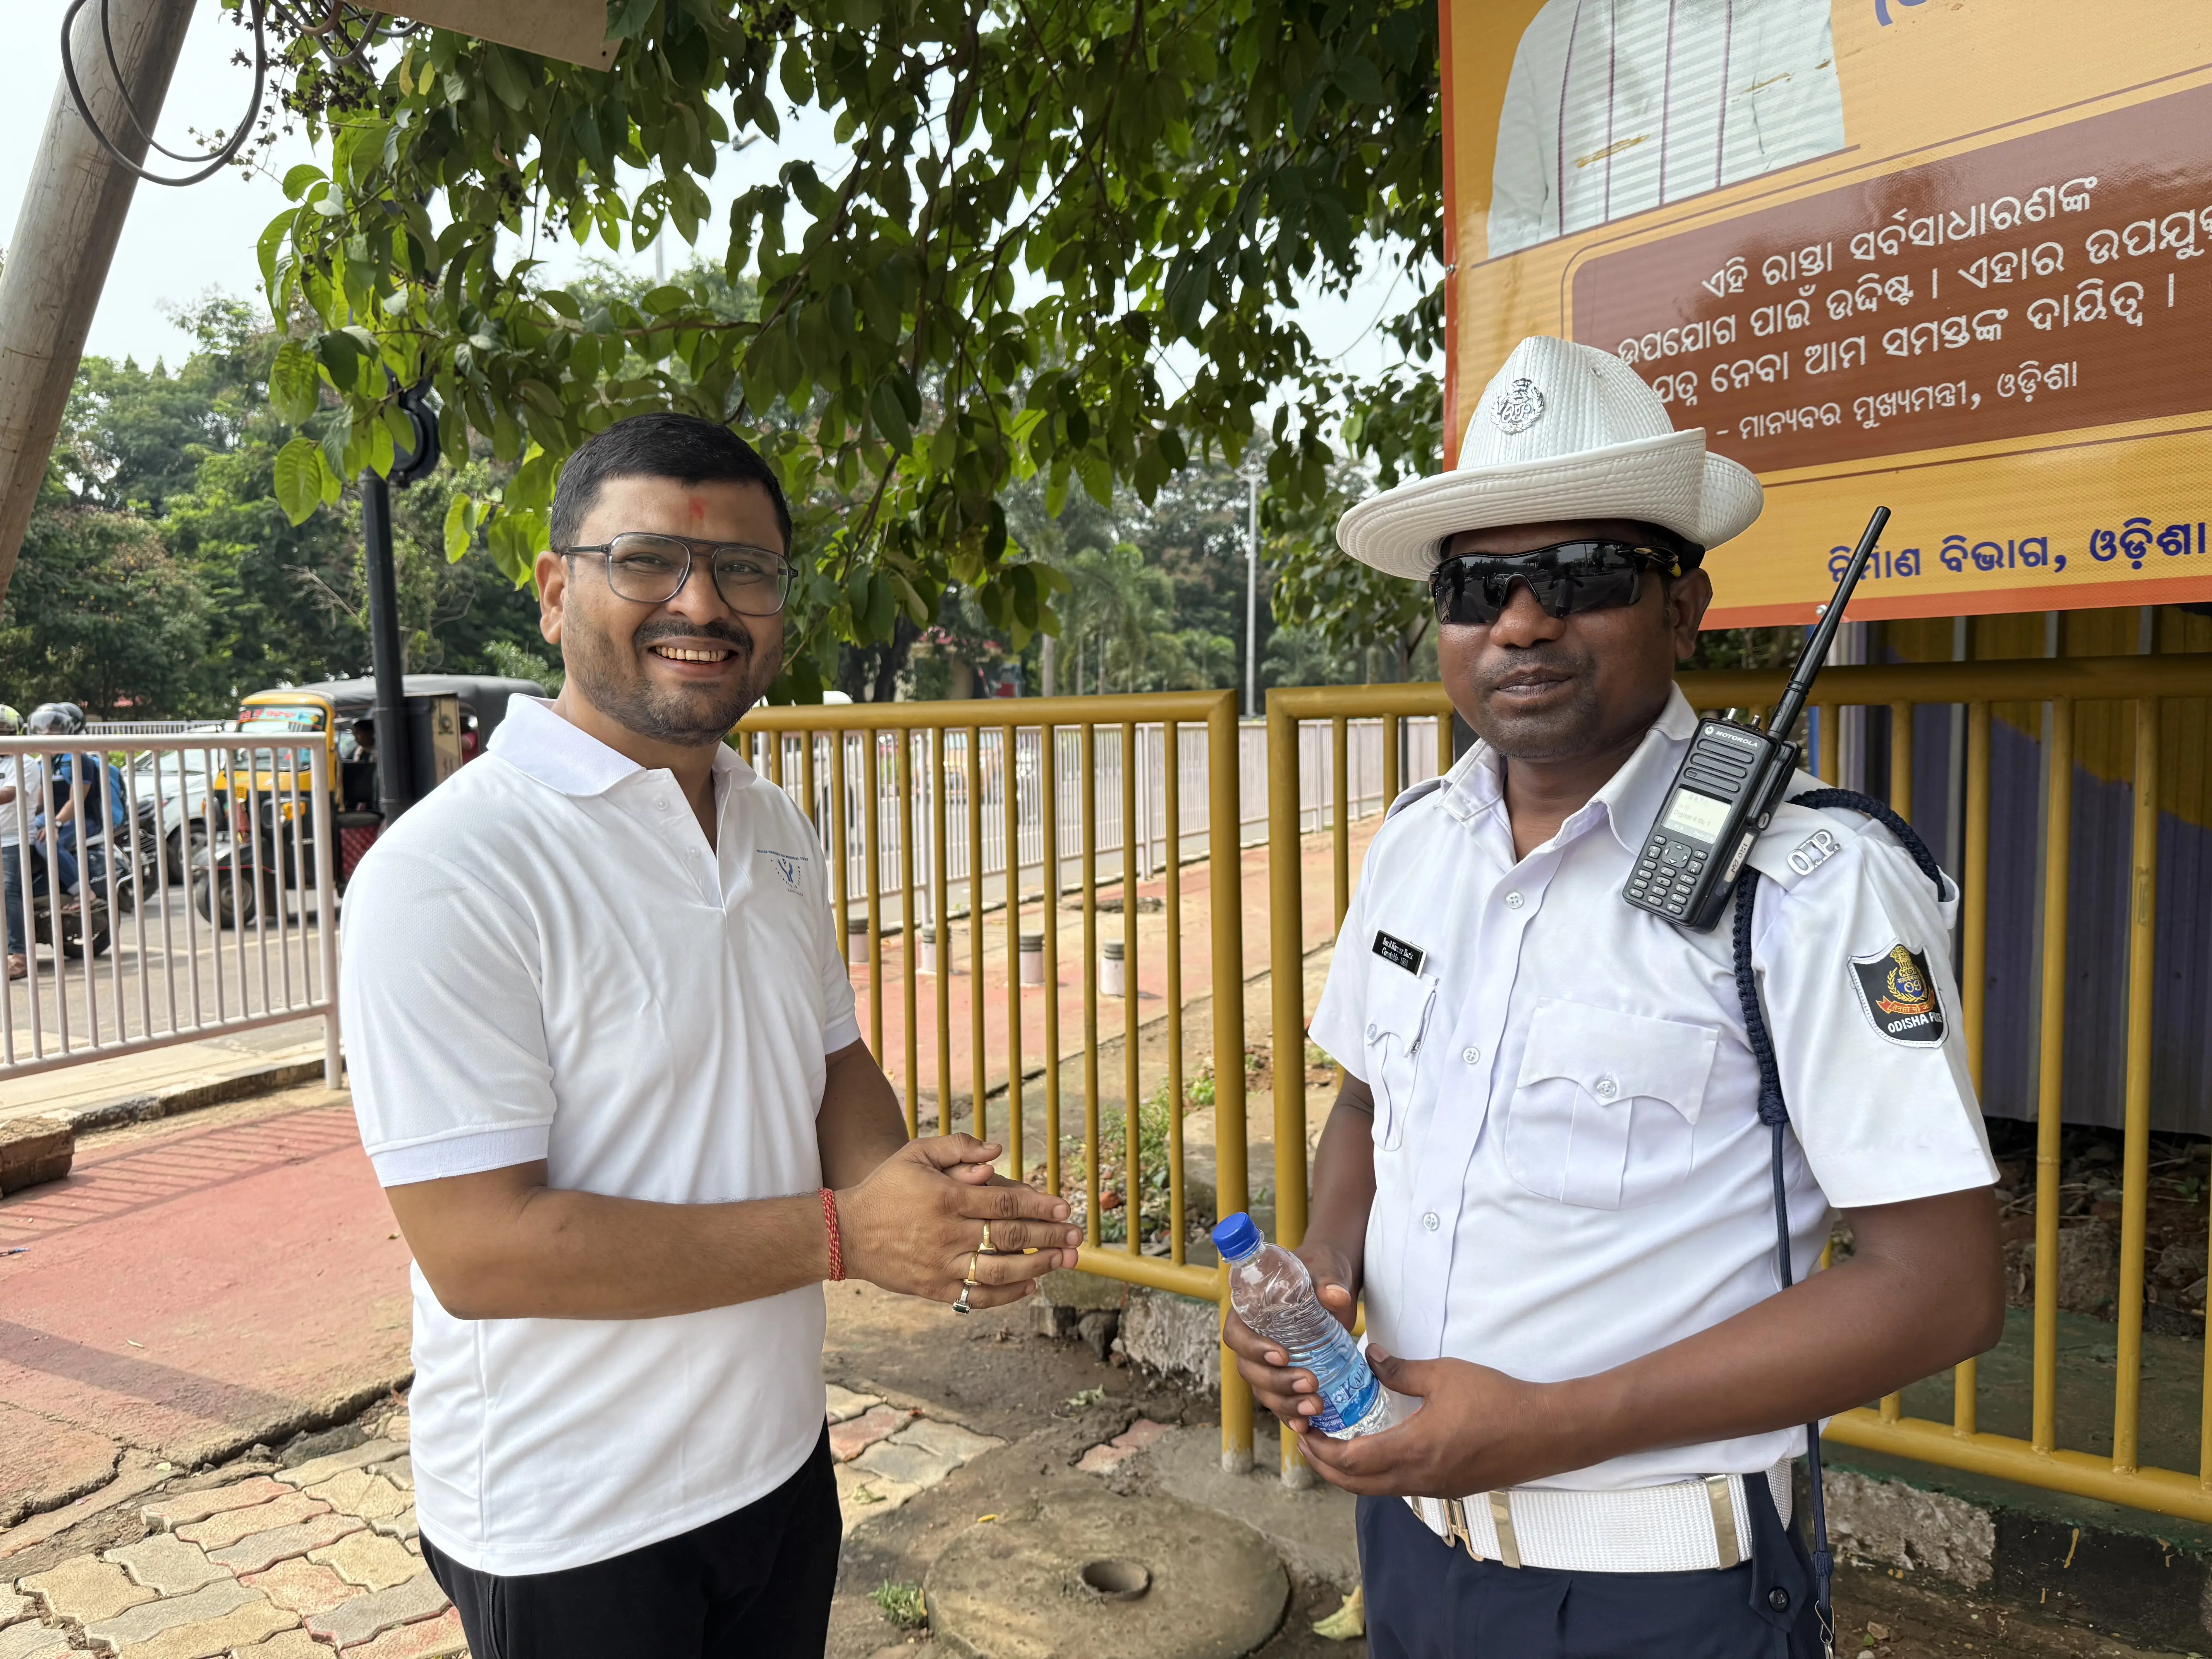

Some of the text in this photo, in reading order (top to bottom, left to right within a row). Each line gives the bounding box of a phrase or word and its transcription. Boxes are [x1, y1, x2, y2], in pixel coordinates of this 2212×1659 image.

[1701, 175, 2099, 298] ଏହି ରାସ୍ତା ସର୍ବସାଧାରଣଙ୍କ
[1618, 314, 1736, 365] ଉପଯୋଗ
[1750, 284, 1816, 337] ପାଇଁ
[1958, 242, 2064, 289] ଏହାର
[2085, 205, 2212, 264] ଉପଯୁ
[1711, 351, 1788, 392] ନେବା
[1804, 335, 1865, 374] ଆମ
[1882, 308, 2009, 357] ସମସ୍ତଙ୍କ
[1739, 403, 1841, 439] ମାନ୍ୟବର
[1997, 360, 2077, 402] ଓଡ଼ିଶା
[2090, 517, 2206, 570] ଓଡ଼ିଶା
[1716, 731, 1758, 747] MOTOROLA
[1673, 809, 1692, 820] Digital
[1887, 1013, 1929, 1033] ODISHA
